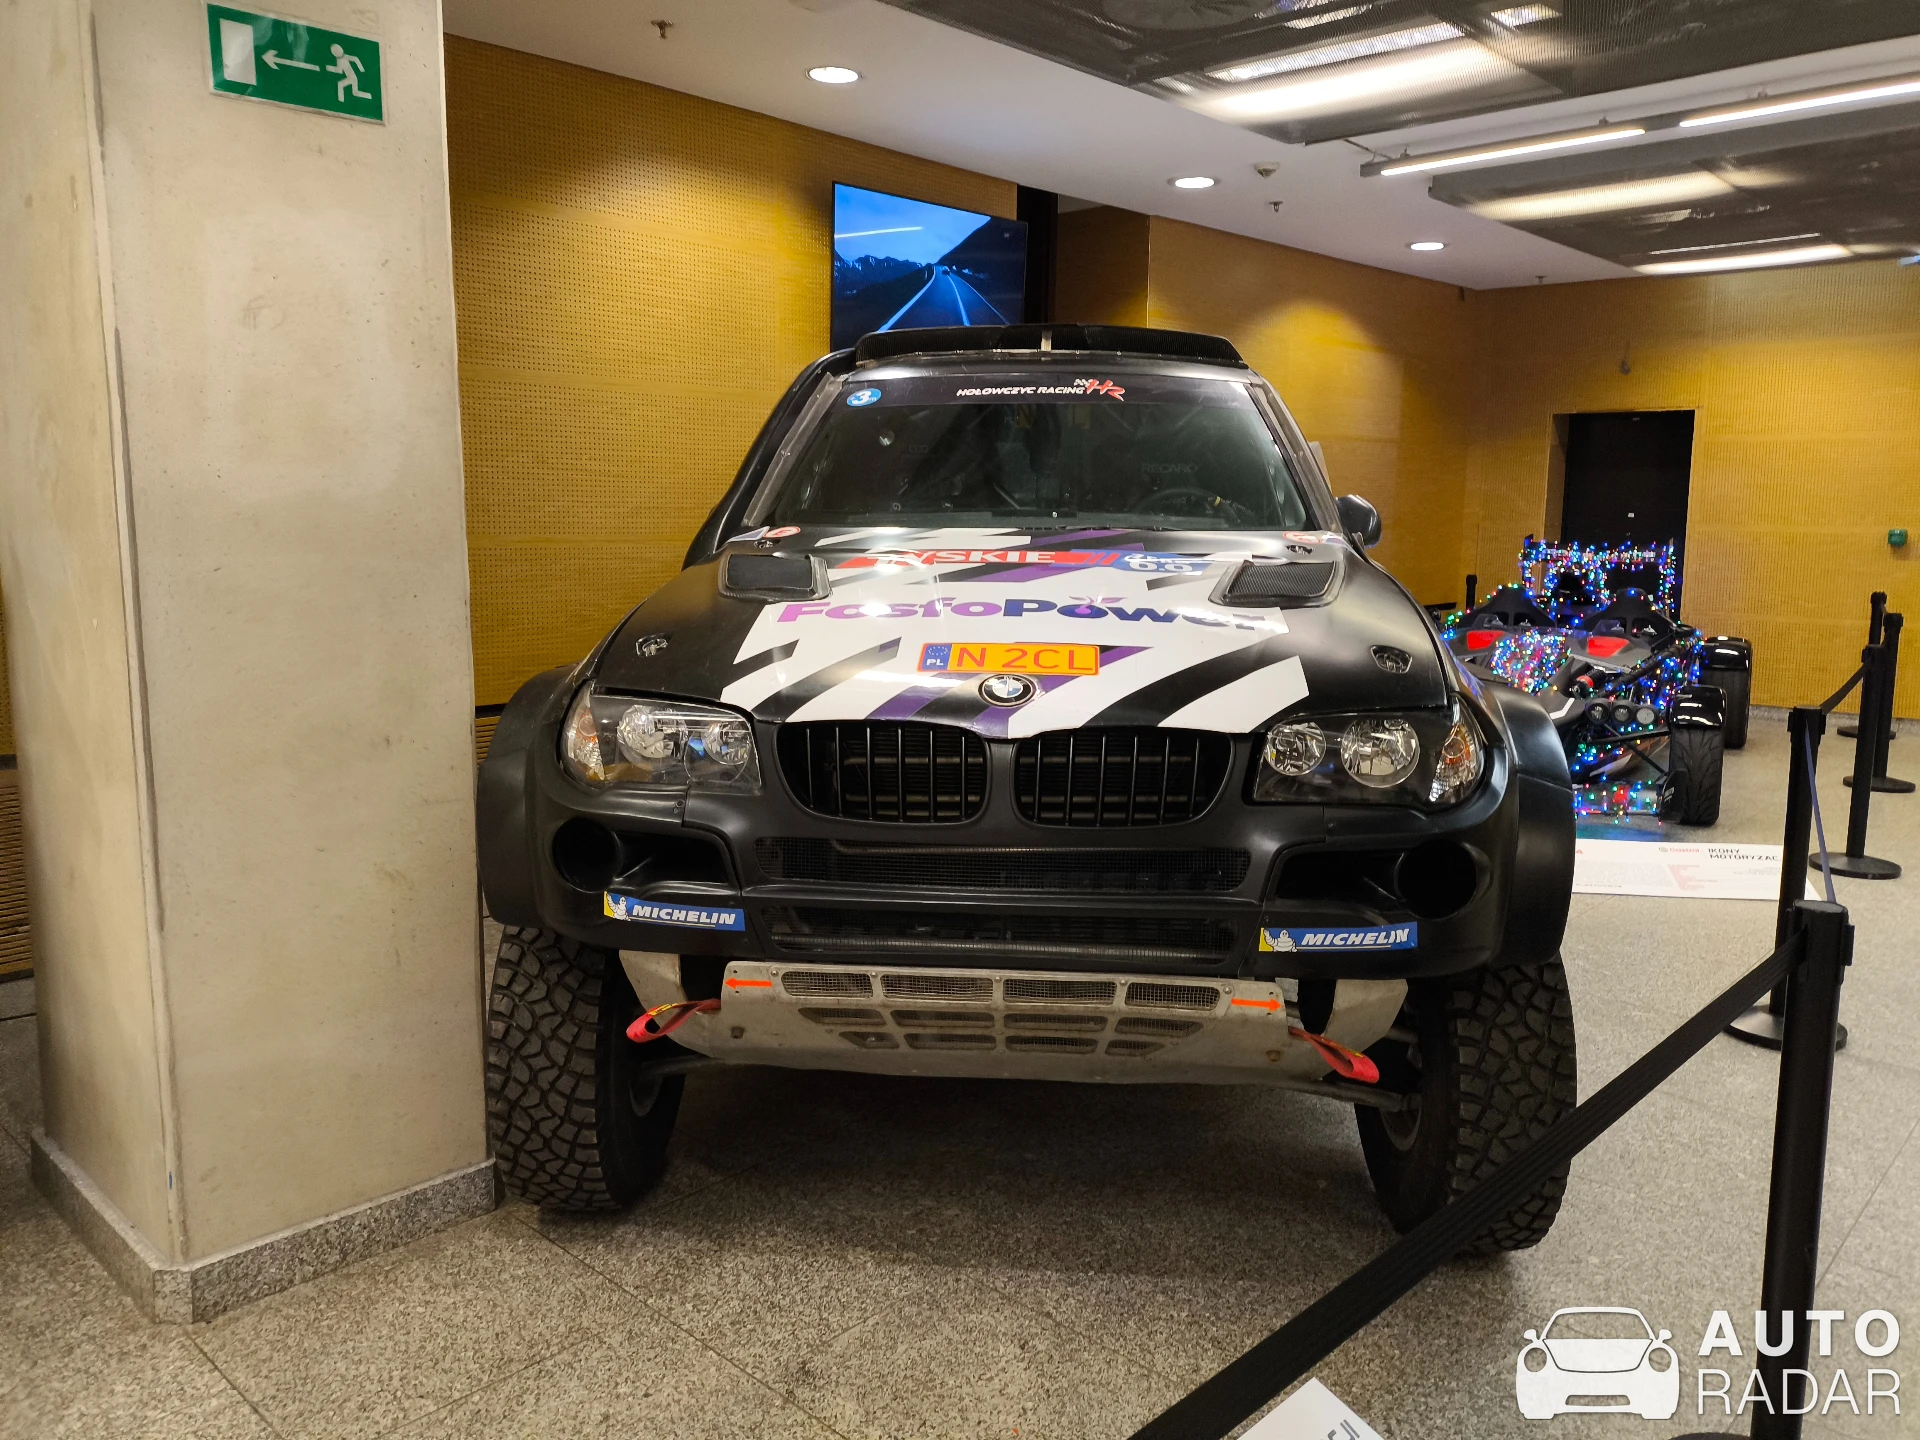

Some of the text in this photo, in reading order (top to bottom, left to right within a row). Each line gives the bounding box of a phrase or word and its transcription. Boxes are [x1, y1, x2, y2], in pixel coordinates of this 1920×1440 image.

[1036, 386, 1085, 395] RACING
[957, 647, 1093, 671] N 2CL
[632, 904, 736, 925] MICHELIN
[1301, 928, 1410, 946] MICHELIN
